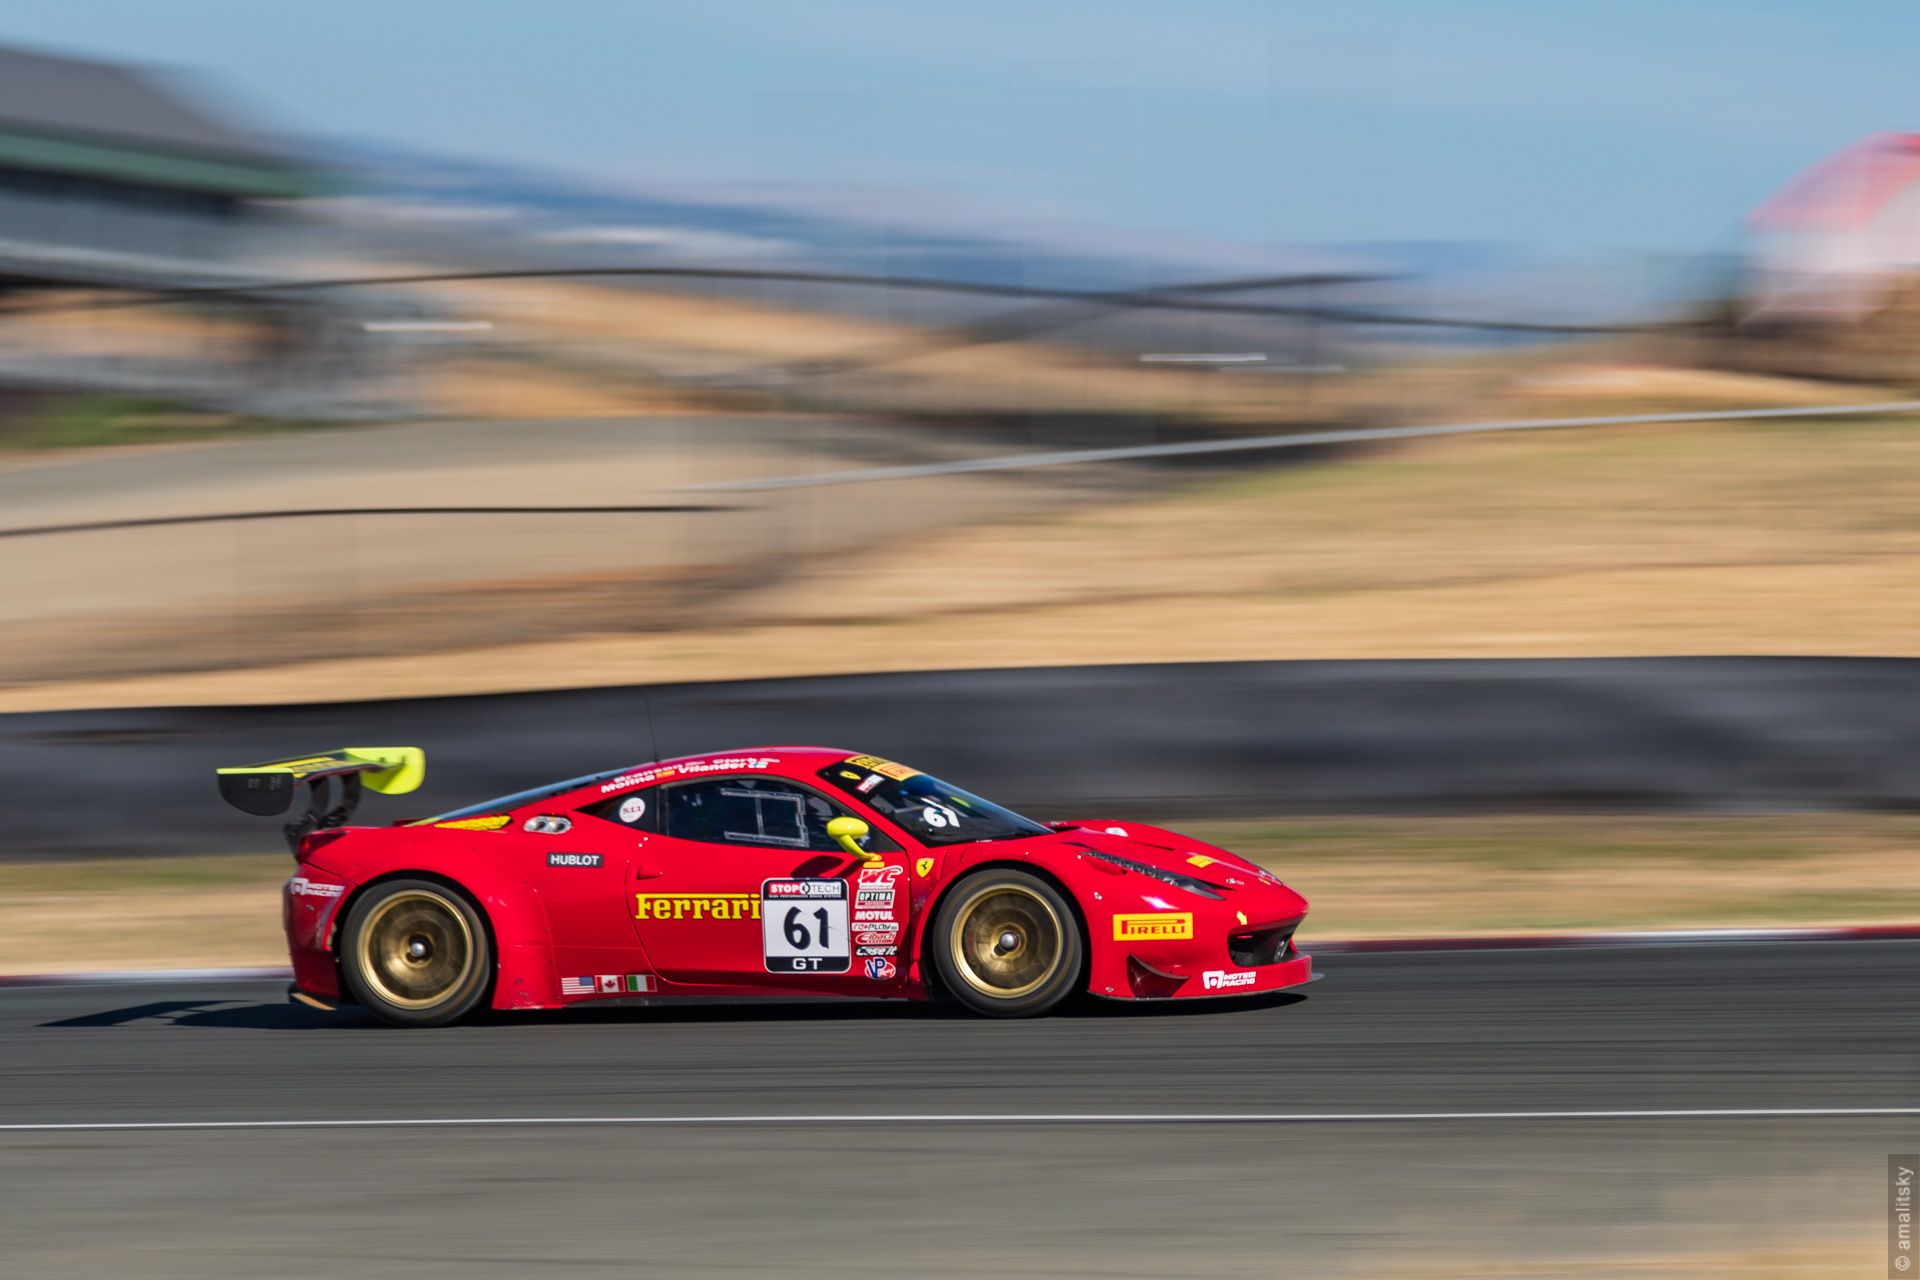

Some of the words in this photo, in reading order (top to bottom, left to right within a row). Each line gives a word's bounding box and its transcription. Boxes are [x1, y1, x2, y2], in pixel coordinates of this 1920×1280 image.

[678, 761, 748, 774] Vilander
[601, 774, 655, 793] Molina
[550, 854, 600, 866] HUBLOT
[770, 883, 800, 894] STOP
[810, 884, 840, 893] TECH
[858, 892, 892, 901] OPTIMA
[635, 893, 761, 920] Ferrari
[854, 910, 895, 921] MOTUL
[783, 906, 830, 951] 61
[1121, 918, 1186, 935] PIRELLI
[792, 957, 823, 970] GT
[866, 957, 886, 979] VP
[1222, 978, 1256, 987] RACING
